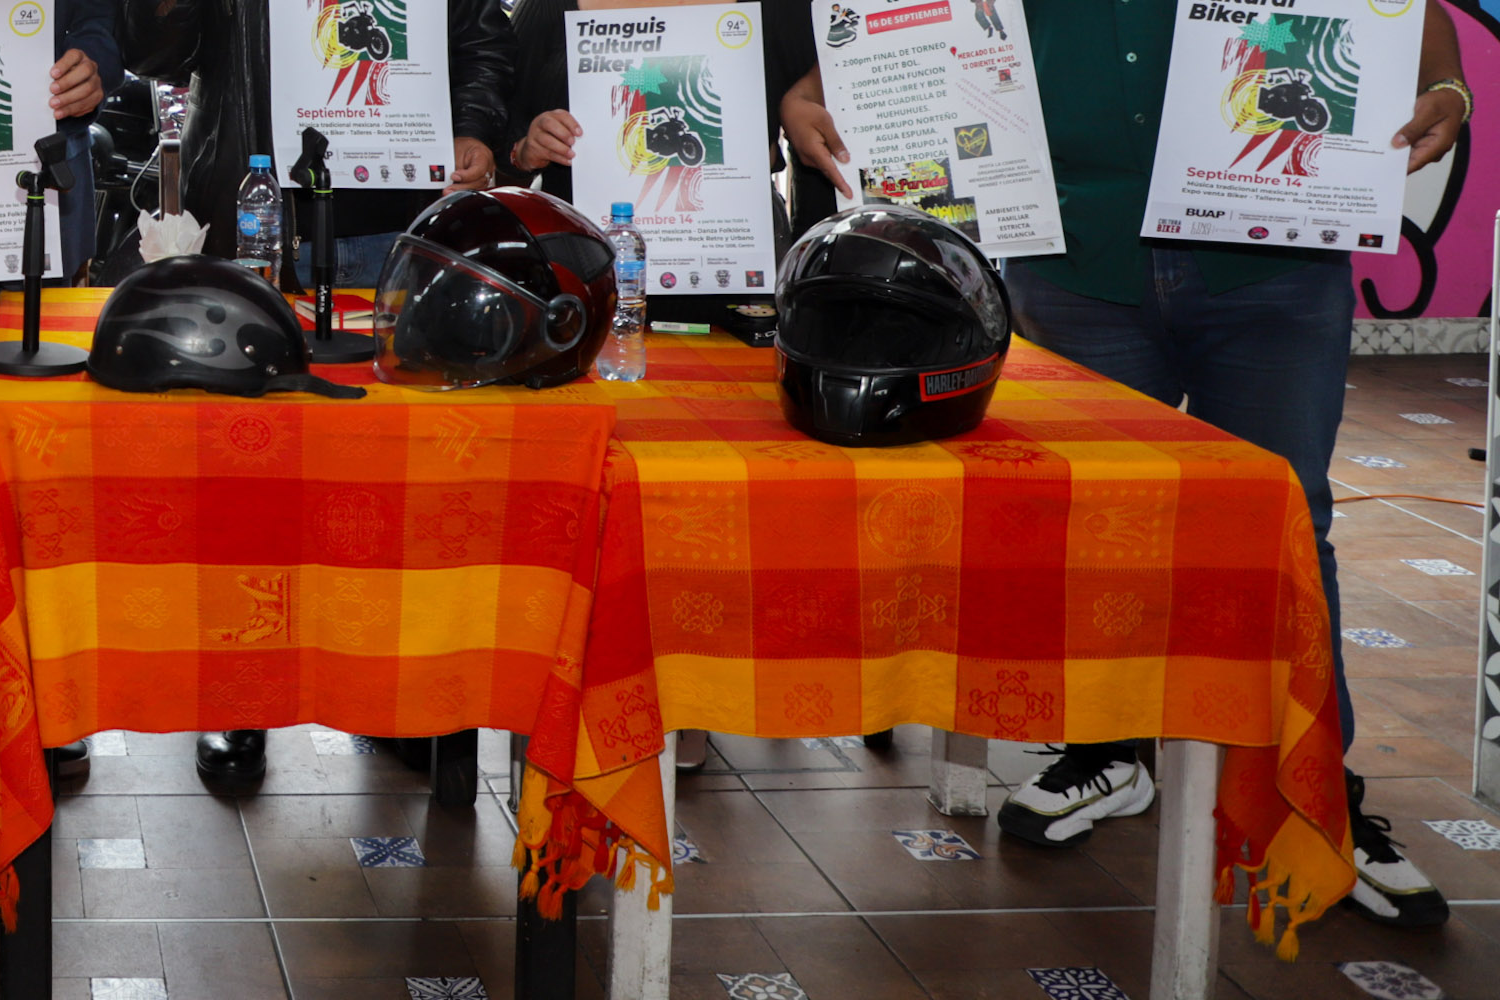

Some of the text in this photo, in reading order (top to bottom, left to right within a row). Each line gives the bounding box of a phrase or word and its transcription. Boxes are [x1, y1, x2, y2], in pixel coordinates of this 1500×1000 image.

[868, 7, 949, 28] 16 DE SEPTIEMBRE
[1189, 4, 1258, 24] Biker
[577, 18, 666, 38] Tianguis
[578, 36, 662, 54] Cultural
[843, 57, 871, 67] 2:00pm
[874, 51, 896, 60] FINAL
[912, 42, 946, 53] TORNEO
[958, 49, 988, 59] MERCADO
[578, 56, 634, 73] Biker
[884, 63, 899, 71] FUT
[970, 59, 995, 68] ORIENTE
[852, 67, 945, 89] 3:00PM GRAN FUNCION
[866, 88, 893, 98] LUCHA
[895, 84, 917, 93] LIBRE
[857, 100, 886, 110] 6:00PM
[888, 94, 934, 106] CUADRILLA
[297, 108, 380, 120] Septiembre 14
[916, 113, 958, 124] NORTEÑO
[876, 133, 899, 142] AGUA
[905, 140, 935, 149] GRUPO
[872, 150, 948, 165] PARADA TROPICAL
[899, 175, 948, 190] Parada
[1187, 167, 1302, 187] Septiembre 14
[1217, 184, 1260, 192] tradicional
[998, 214, 1029, 222] FAMILIAR
[1185, 208, 1225, 218] BUAP
[240, 218, 256, 229] ciel
[680, 215, 692, 224] 14
[1000, 223, 1030, 231] ESTRICTA
[1157, 225, 1180, 233] BIKER
[997, 231, 1036, 239] VIGILANCIA
